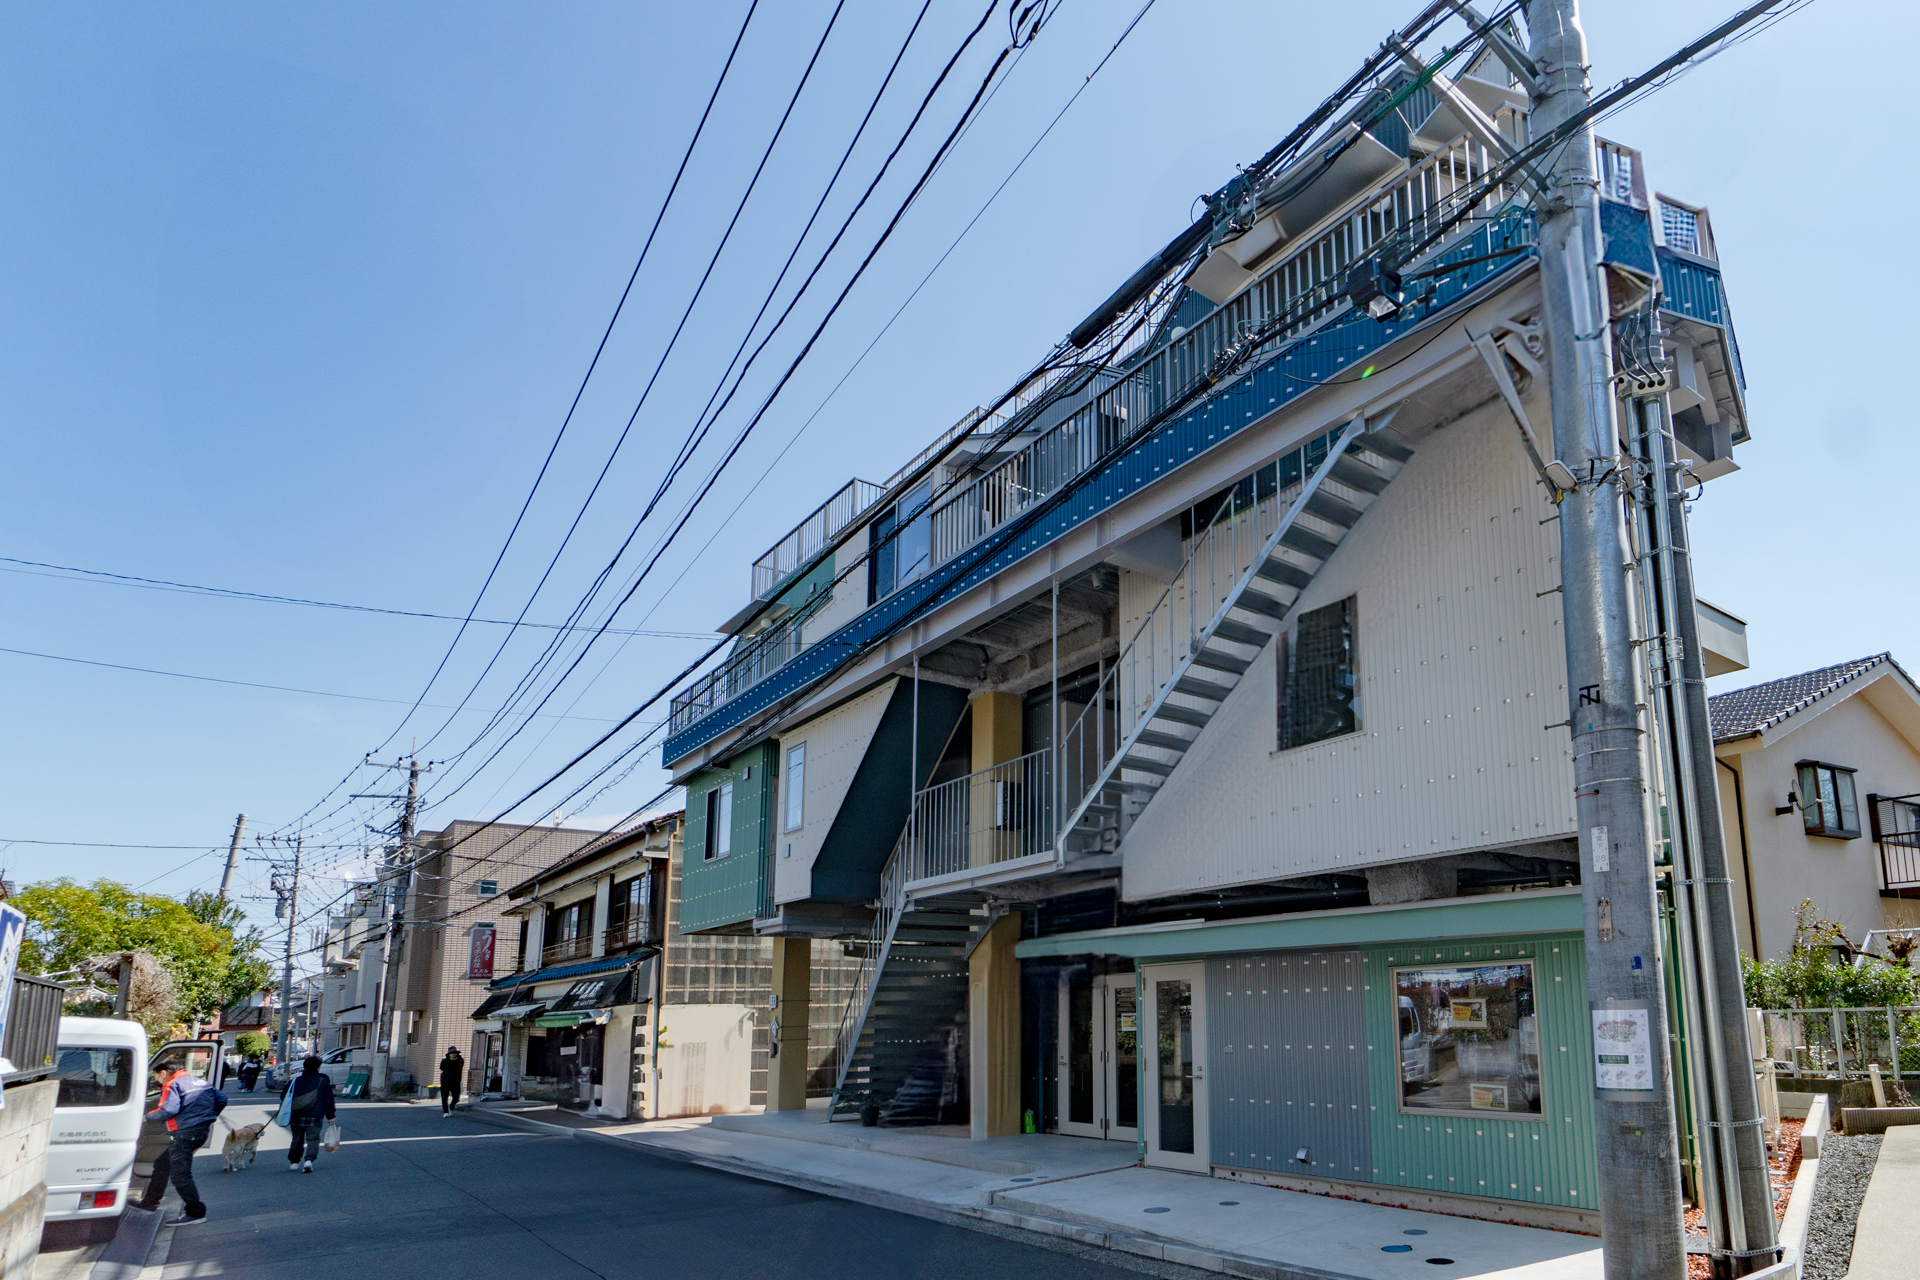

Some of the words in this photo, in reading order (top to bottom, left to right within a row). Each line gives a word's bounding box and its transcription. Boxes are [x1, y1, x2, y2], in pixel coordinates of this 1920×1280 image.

[473, 941, 481, 968] スッポン料理
[482, 930, 493, 960] うなぎ
